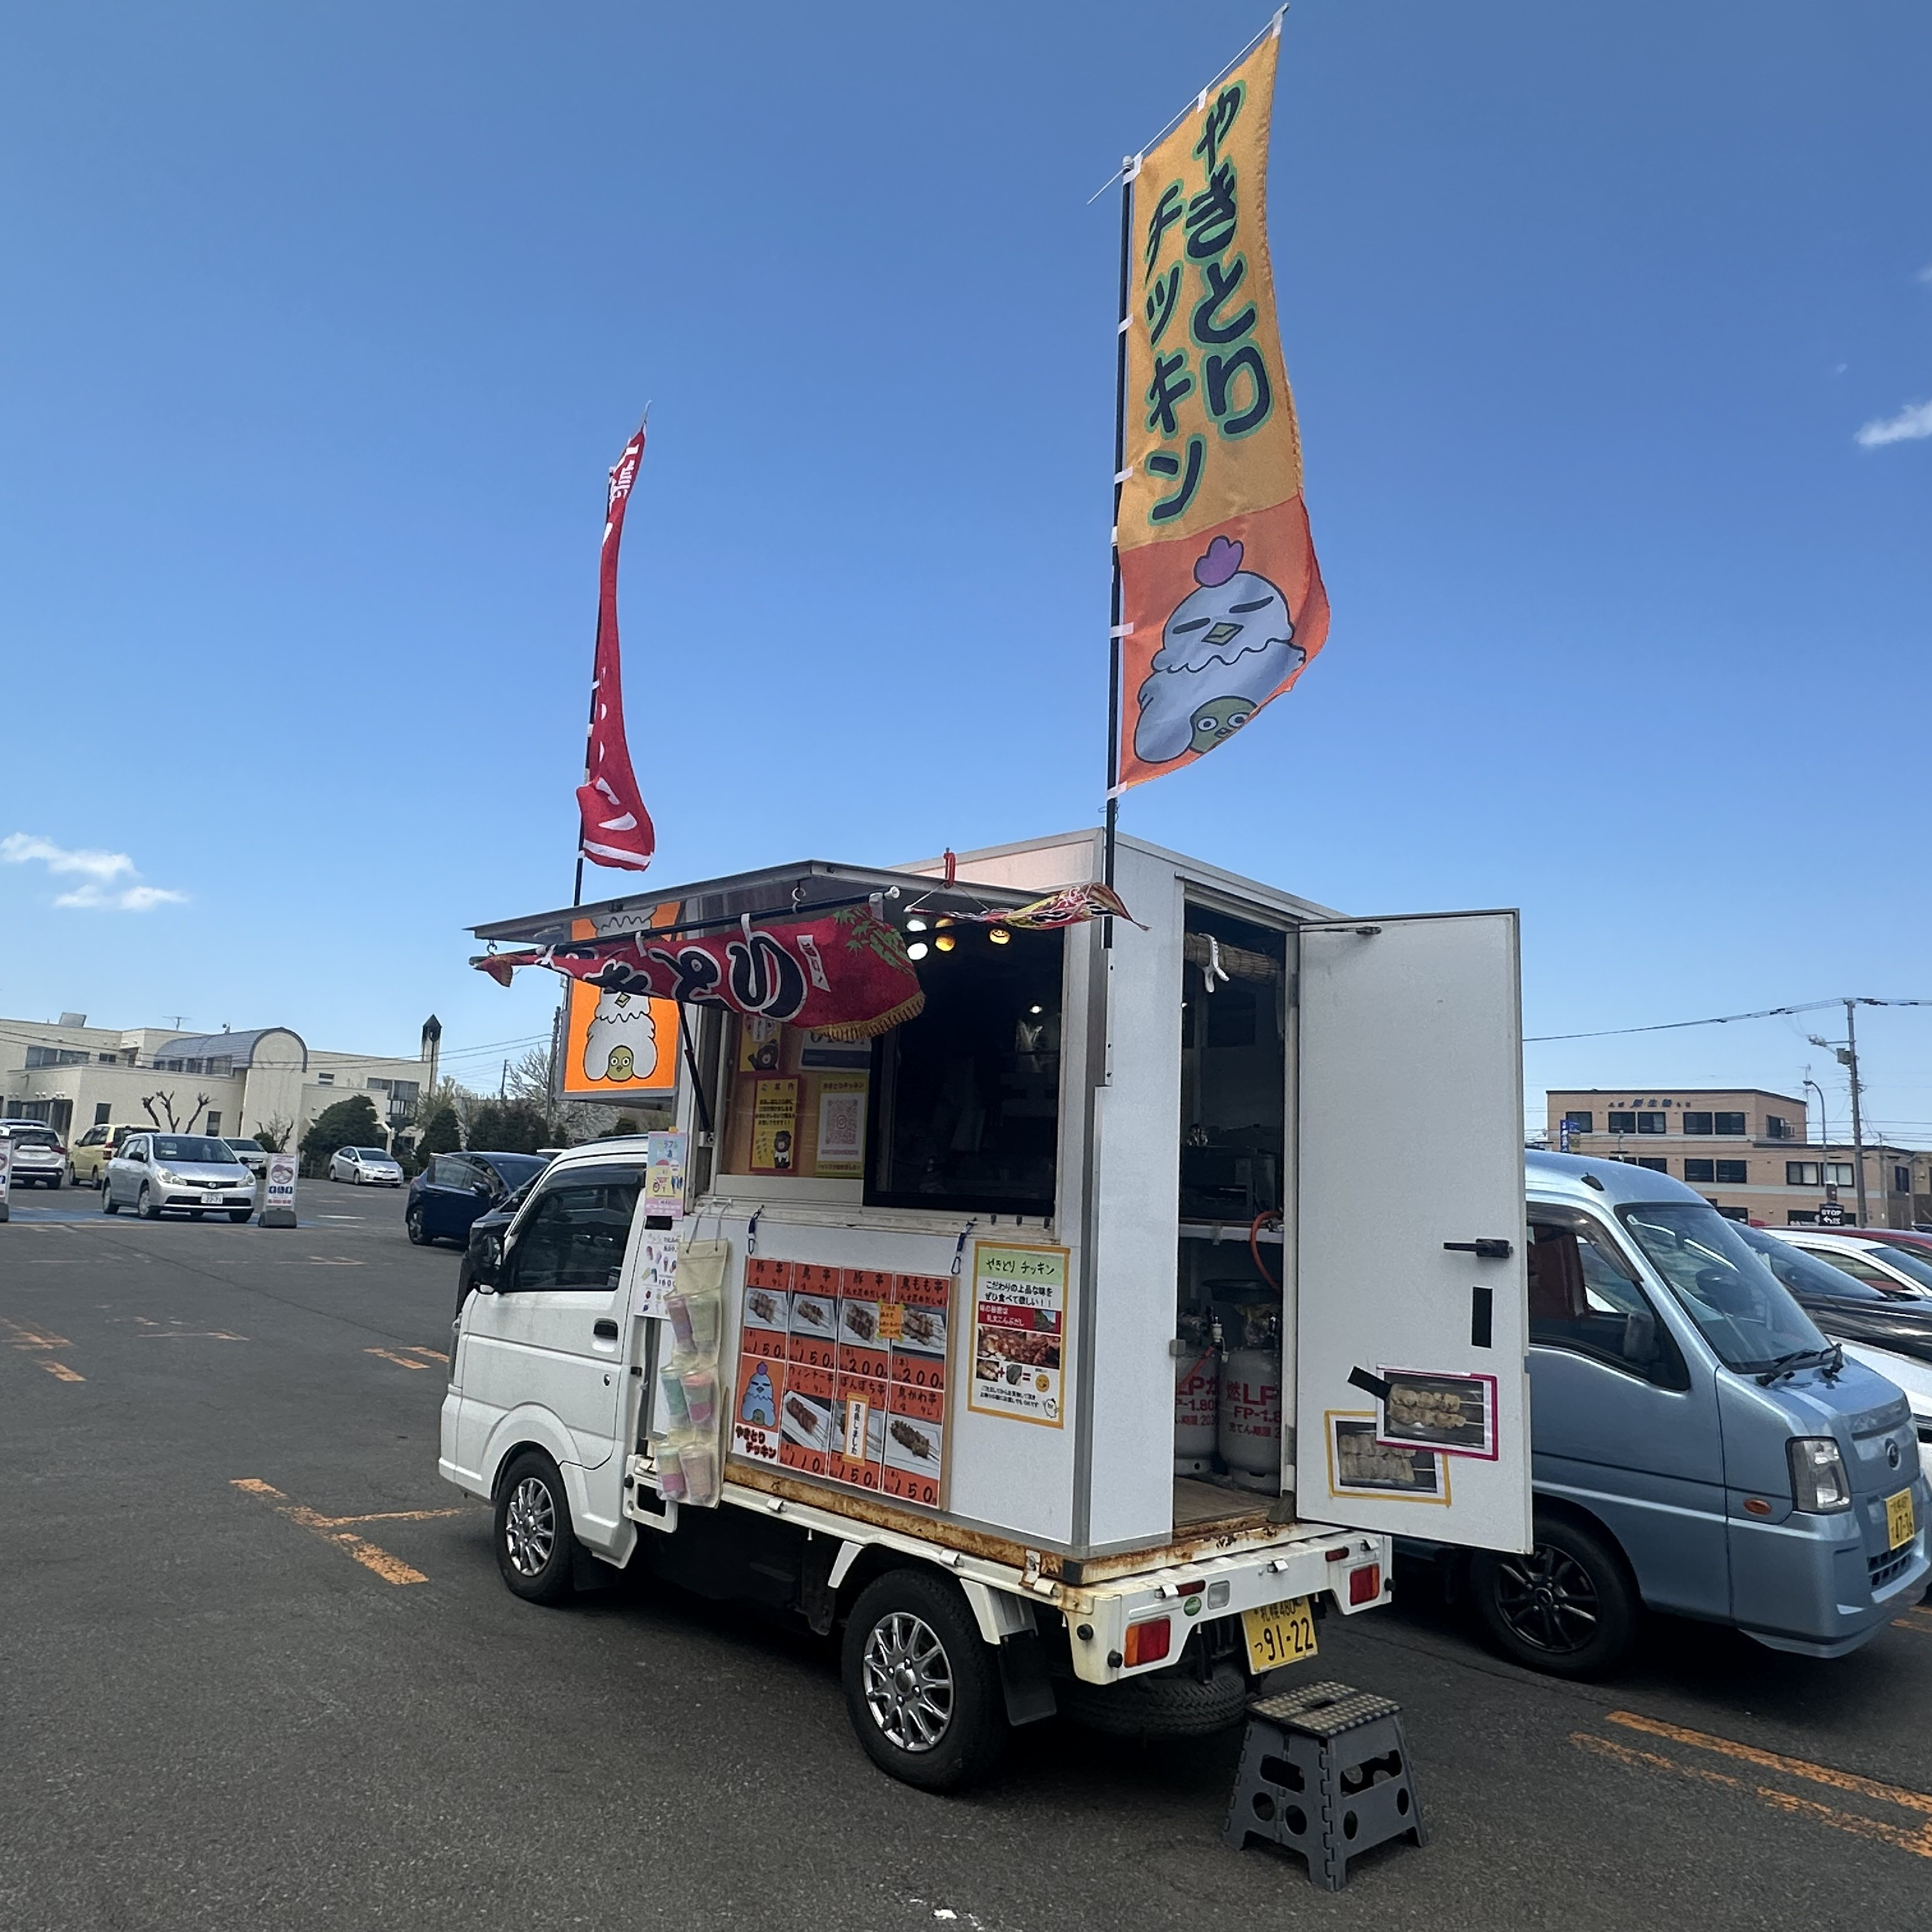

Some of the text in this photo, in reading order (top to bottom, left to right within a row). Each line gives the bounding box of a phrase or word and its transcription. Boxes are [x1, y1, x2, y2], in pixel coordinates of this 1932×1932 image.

[1186, 84, 1271, 436] やきとり
[1145, 185, 1203, 521] チッキン
[986, 1257, 1055, 1275] やきとり チッキン
[986, 1280, 1054, 1298] こだわりの上品な味を
[735, 1425, 766, 1444] やきとり
[745, 1441, 777, 1459] チッキン
[1263, 1617, 1314, 1661] 91-22
